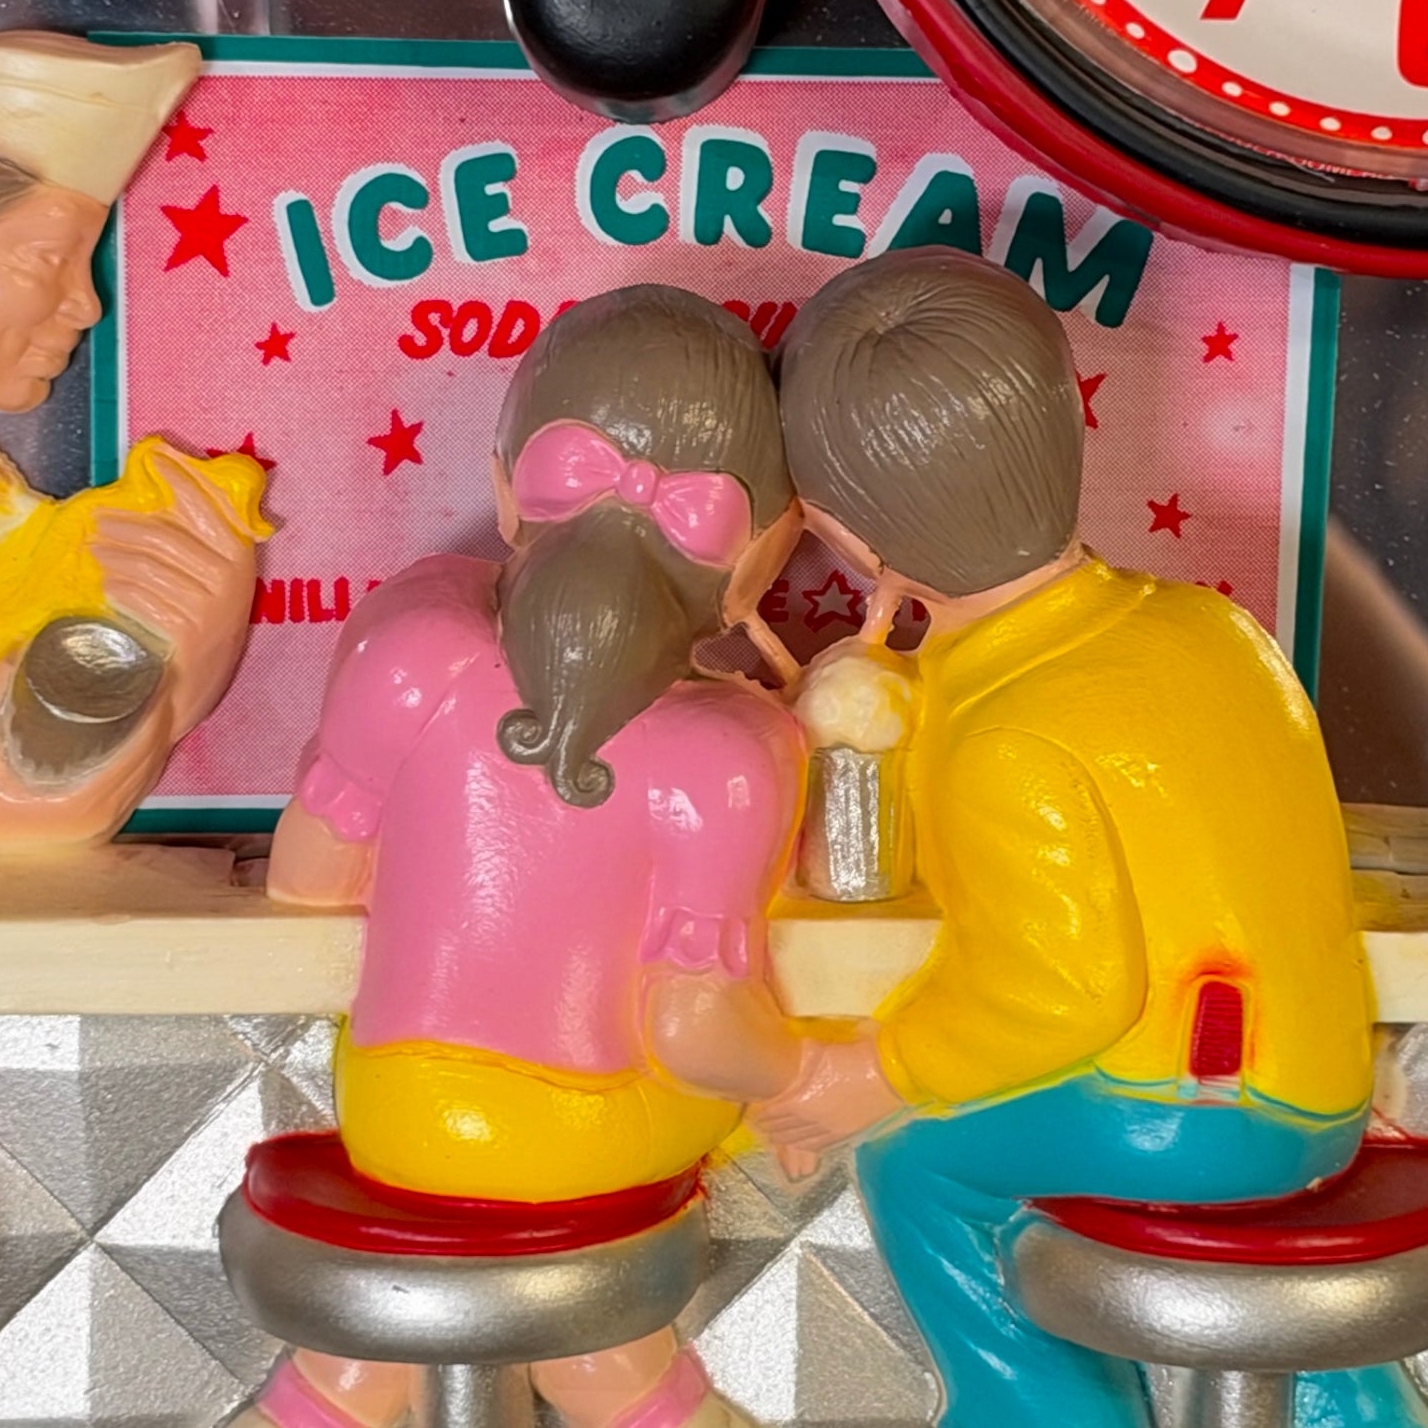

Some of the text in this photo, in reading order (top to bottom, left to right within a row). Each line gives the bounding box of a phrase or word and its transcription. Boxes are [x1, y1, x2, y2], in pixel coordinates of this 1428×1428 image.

[279, 134, 1154, 329] ICE CREAM
[398, 298, 581, 361] SOD
